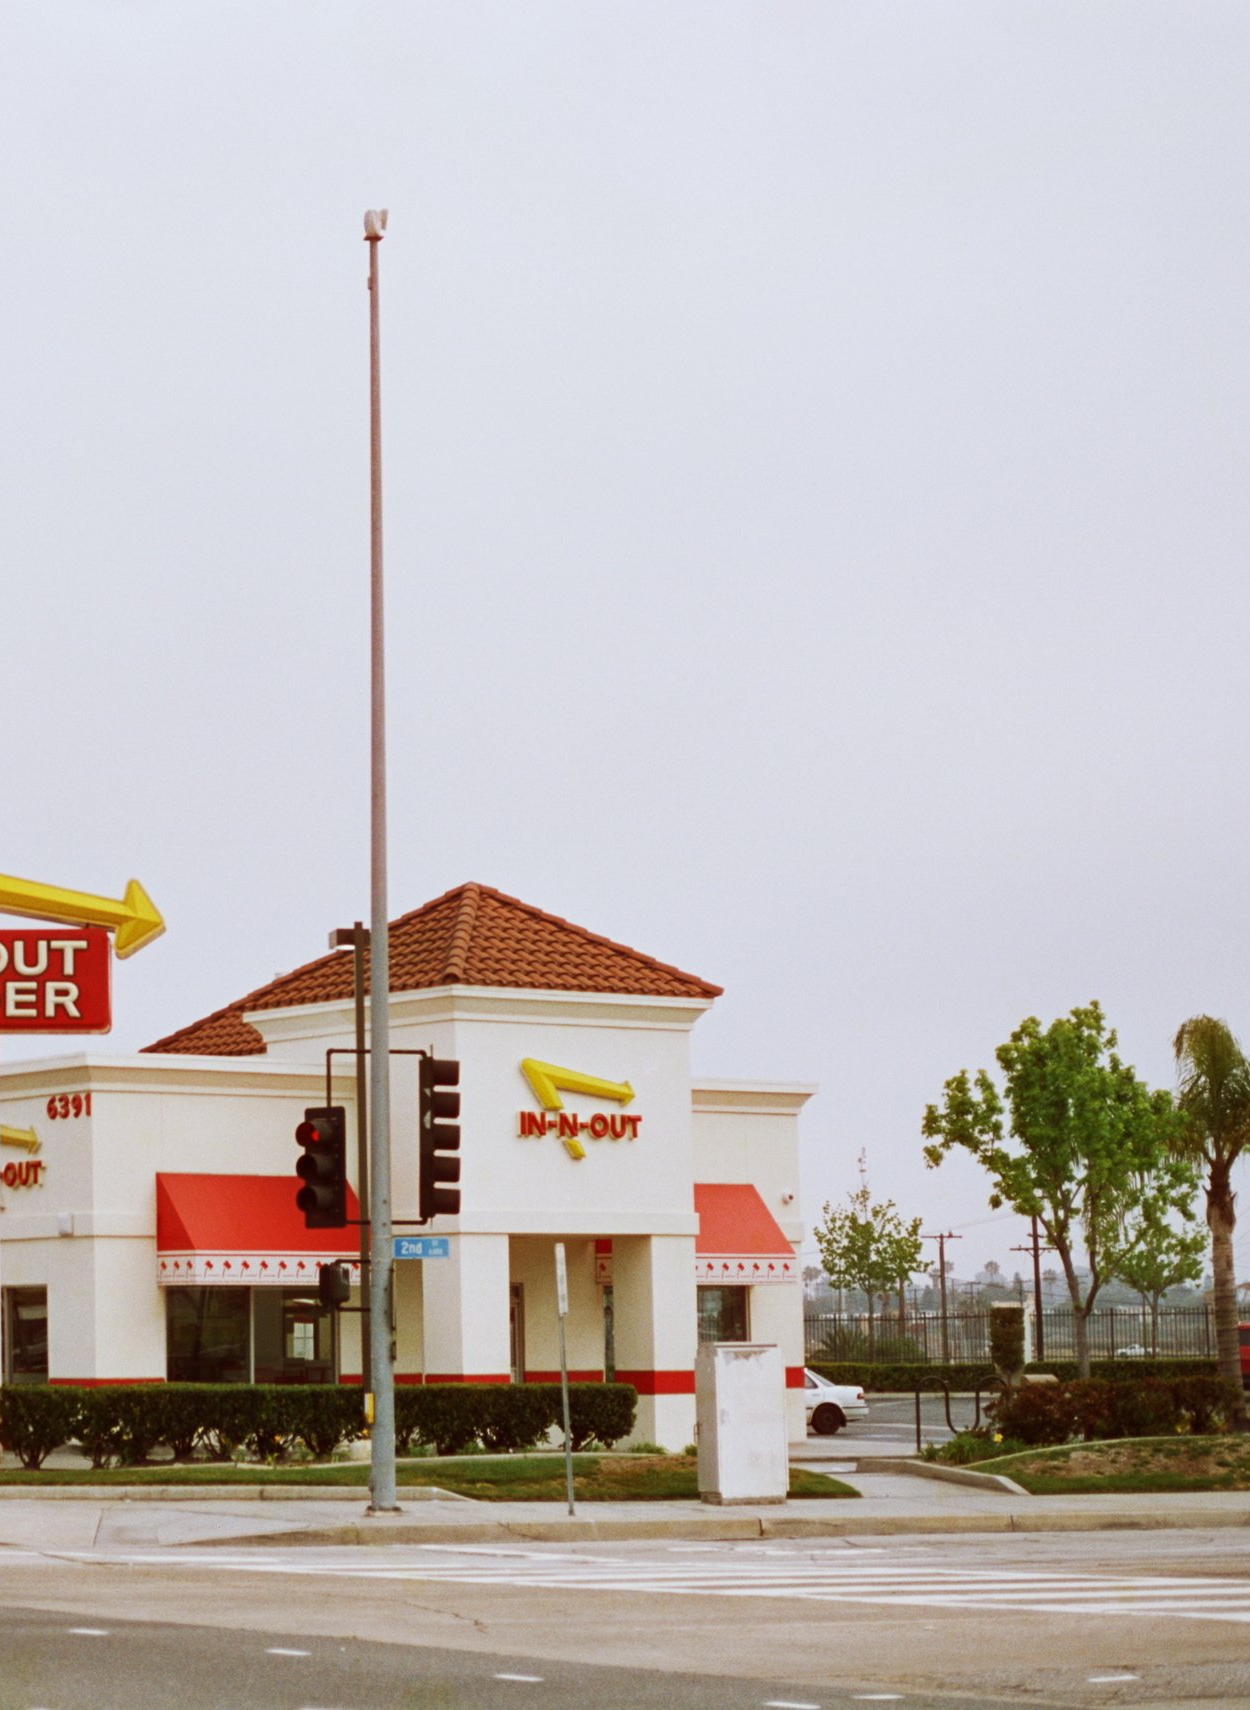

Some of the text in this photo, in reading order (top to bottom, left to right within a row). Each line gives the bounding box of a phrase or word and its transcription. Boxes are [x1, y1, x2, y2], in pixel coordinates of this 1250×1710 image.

[46, 1090, 92, 1120] 6391
[519, 1111, 643, 1139] IN-N-OUT
[401, 1241, 423, 1255] 2nd
